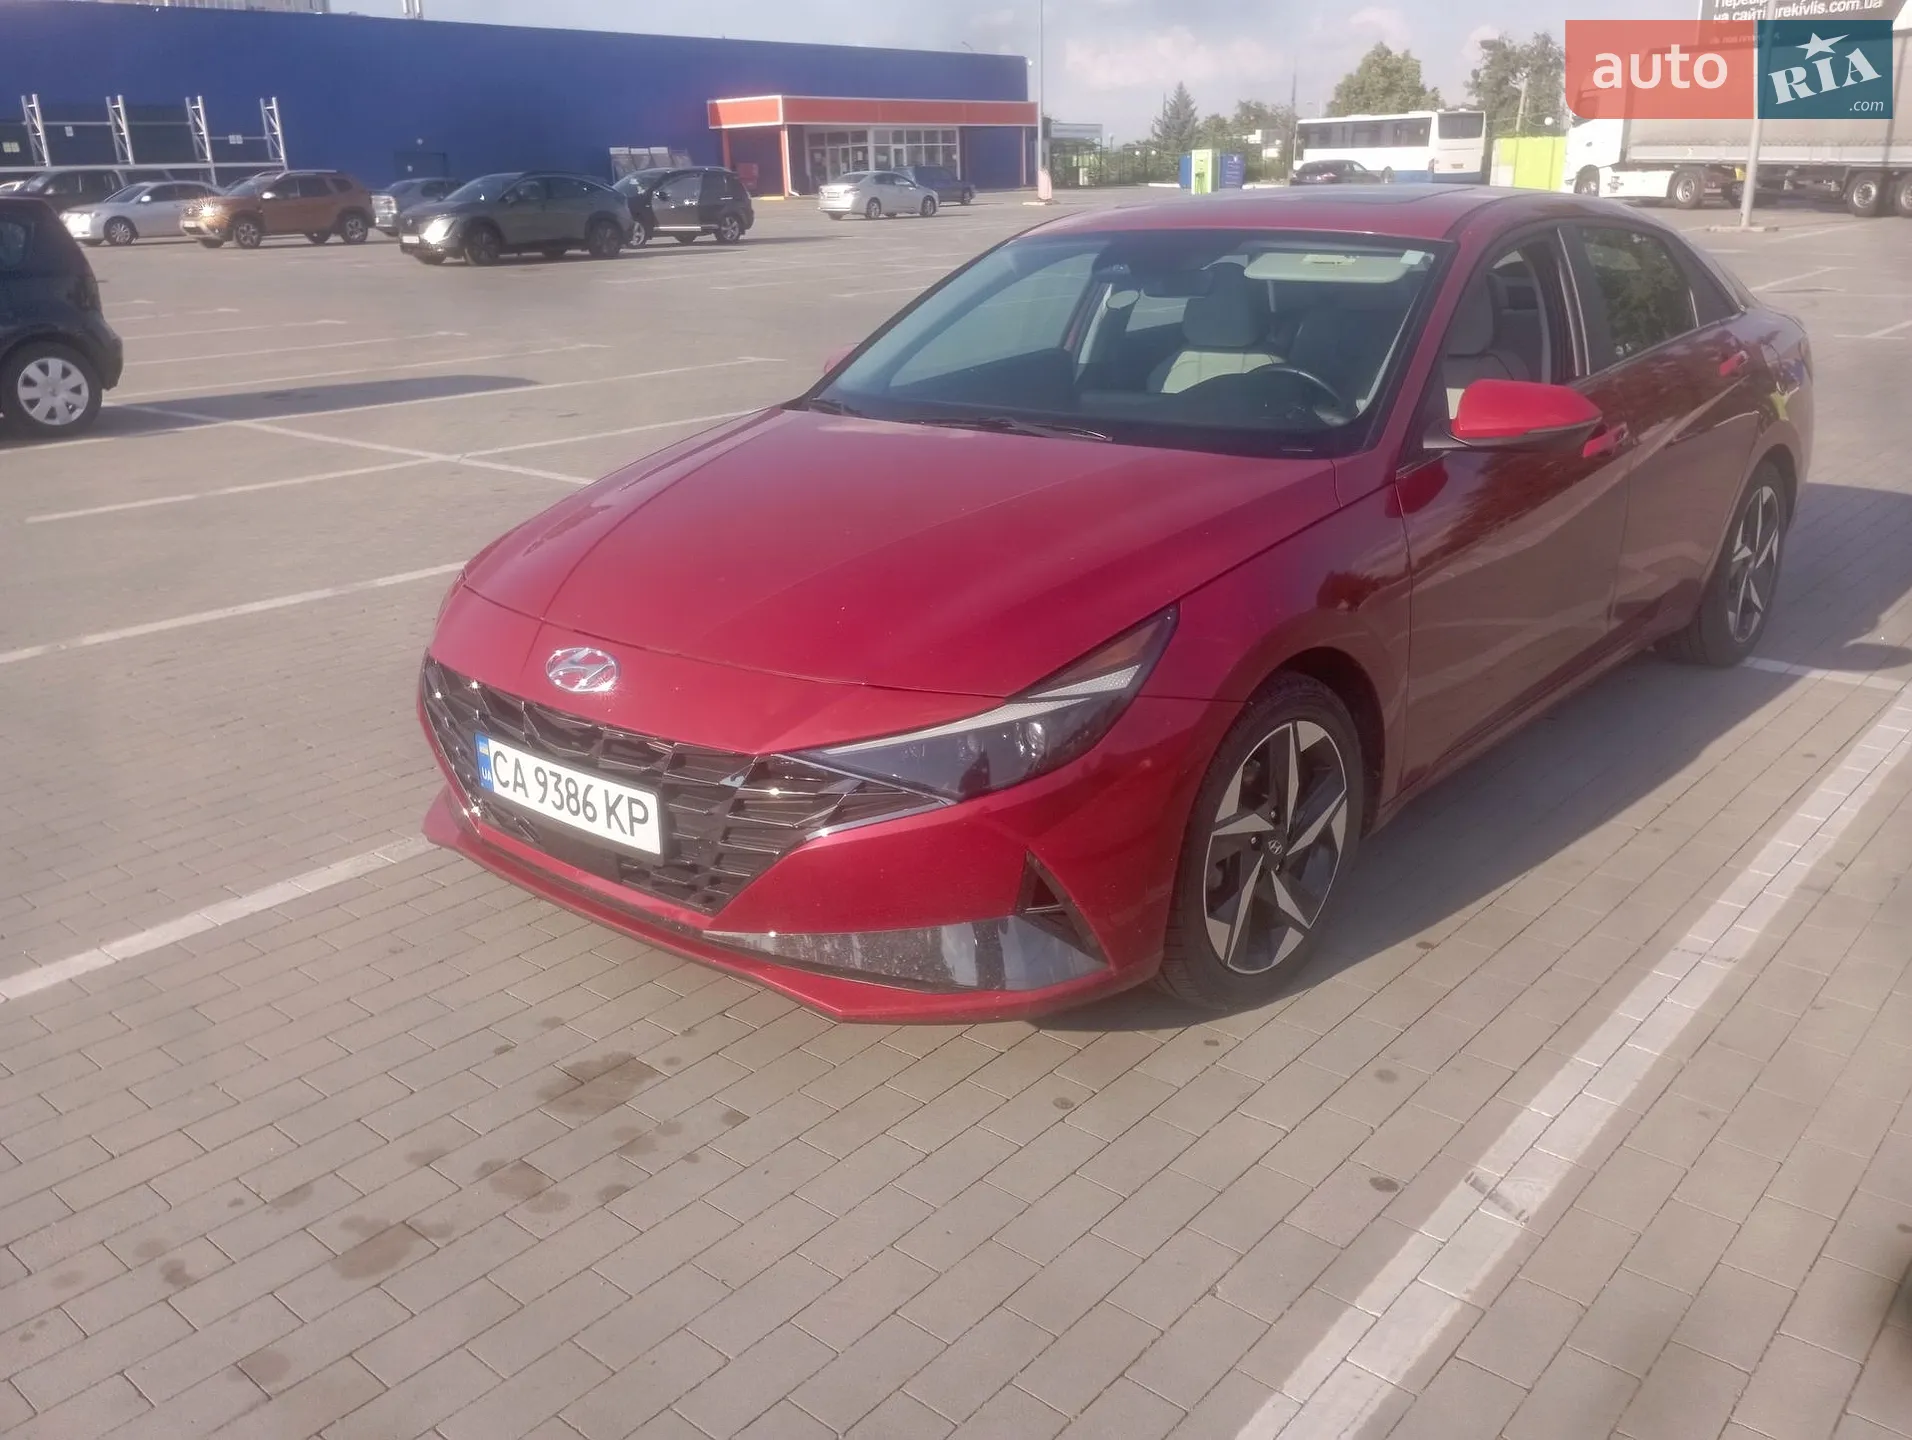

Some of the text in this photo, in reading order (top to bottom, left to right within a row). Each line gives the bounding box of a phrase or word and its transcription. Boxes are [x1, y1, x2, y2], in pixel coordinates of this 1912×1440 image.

[1774, 0, 1883, 18] rekivlis.com.ua
[481, 766, 493, 783] UA
[493, 751, 649, 837] CA 9386 KP
